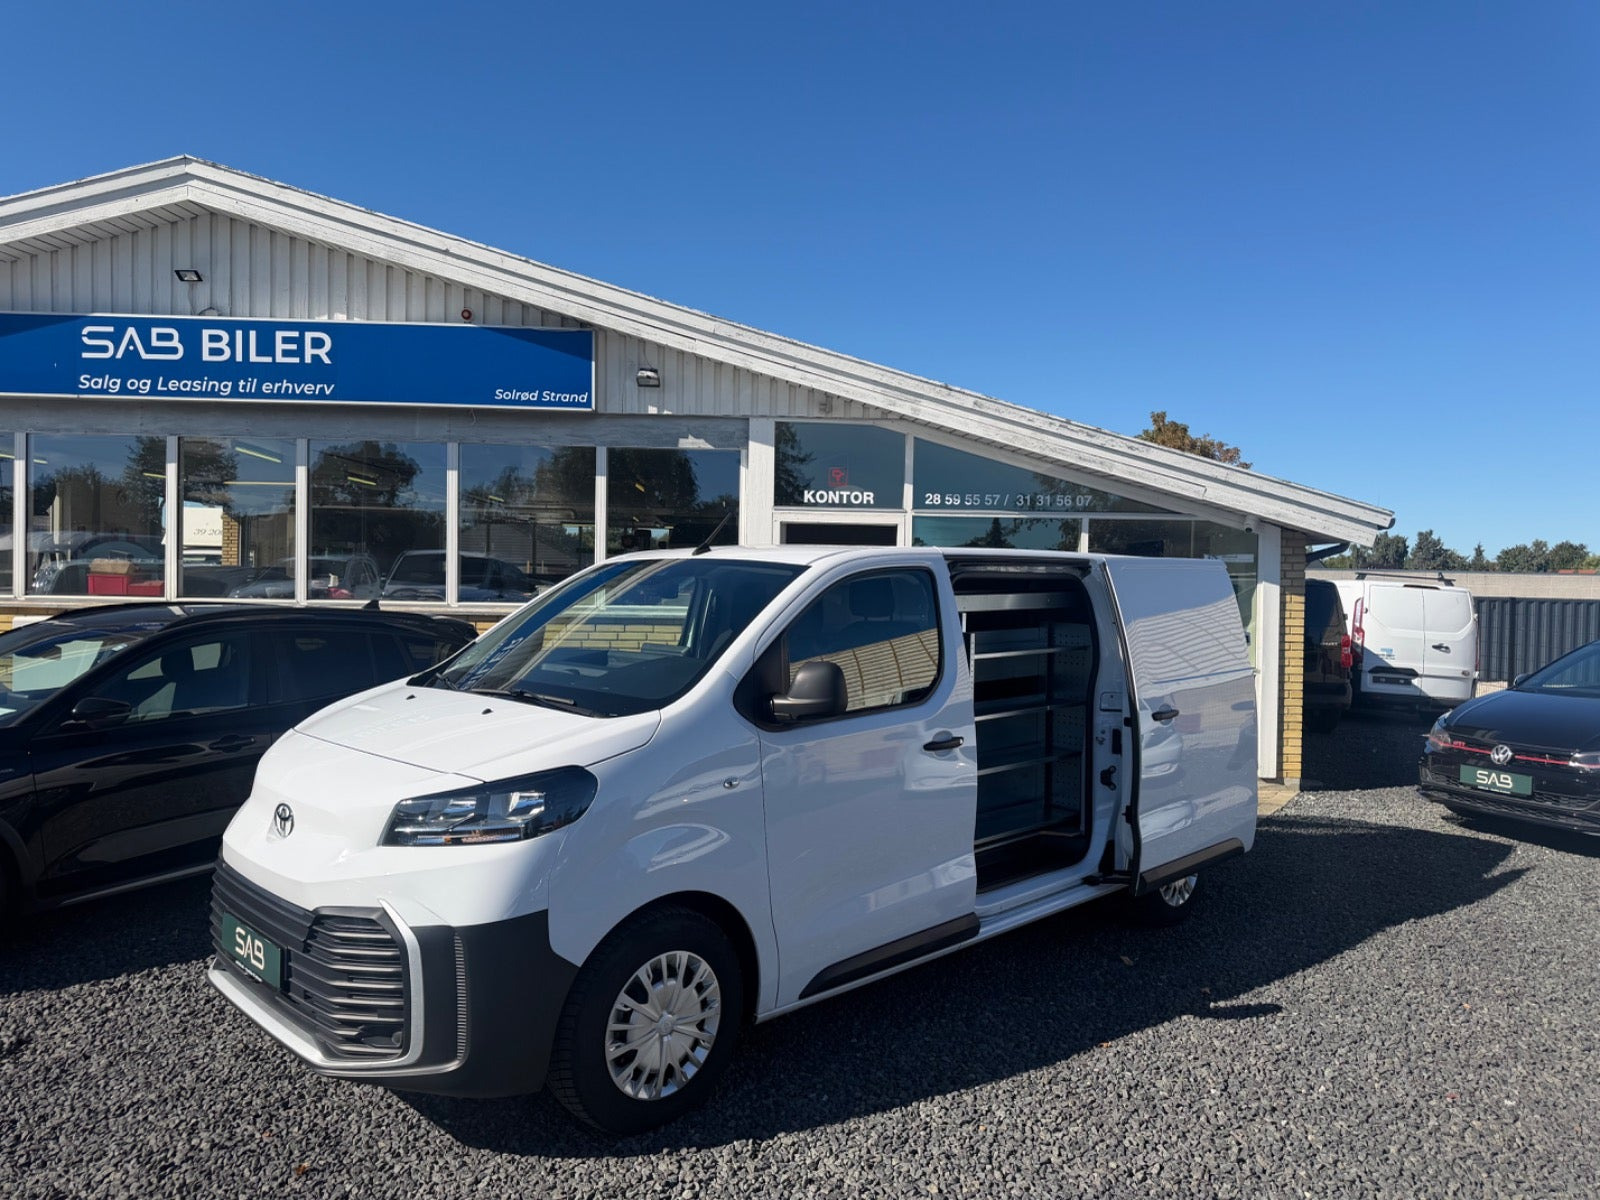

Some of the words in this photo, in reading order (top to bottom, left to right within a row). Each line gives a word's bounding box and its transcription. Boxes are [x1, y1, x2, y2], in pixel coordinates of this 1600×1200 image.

[81, 326, 184, 360] SAB
[202, 329, 332, 364] BILER
[78, 374, 121, 393] Salg
[126, 378, 151, 393] og
[157, 376, 232, 396] Leasing
[238, 377, 258, 393] til
[262, 379, 335, 396] erhverv
[494, 389, 539, 401] Solrød
[542, 390, 588, 403] Strand
[803, 490, 874, 504] KONTOR
[924, 493, 941, 505] 28
[944, 493, 961, 505] 59
[964, 494, 980, 506] 55
[984, 494, 1000, 506] 57
[1016, 494, 1031, 506] 31
[1036, 494, 1051, 506] 31
[1056, 495, 1072, 506] 56
[1076, 495, 1093, 506] 07
[1476, 770, 1513, 789] SAB
[235, 927, 265, 970] SAB
